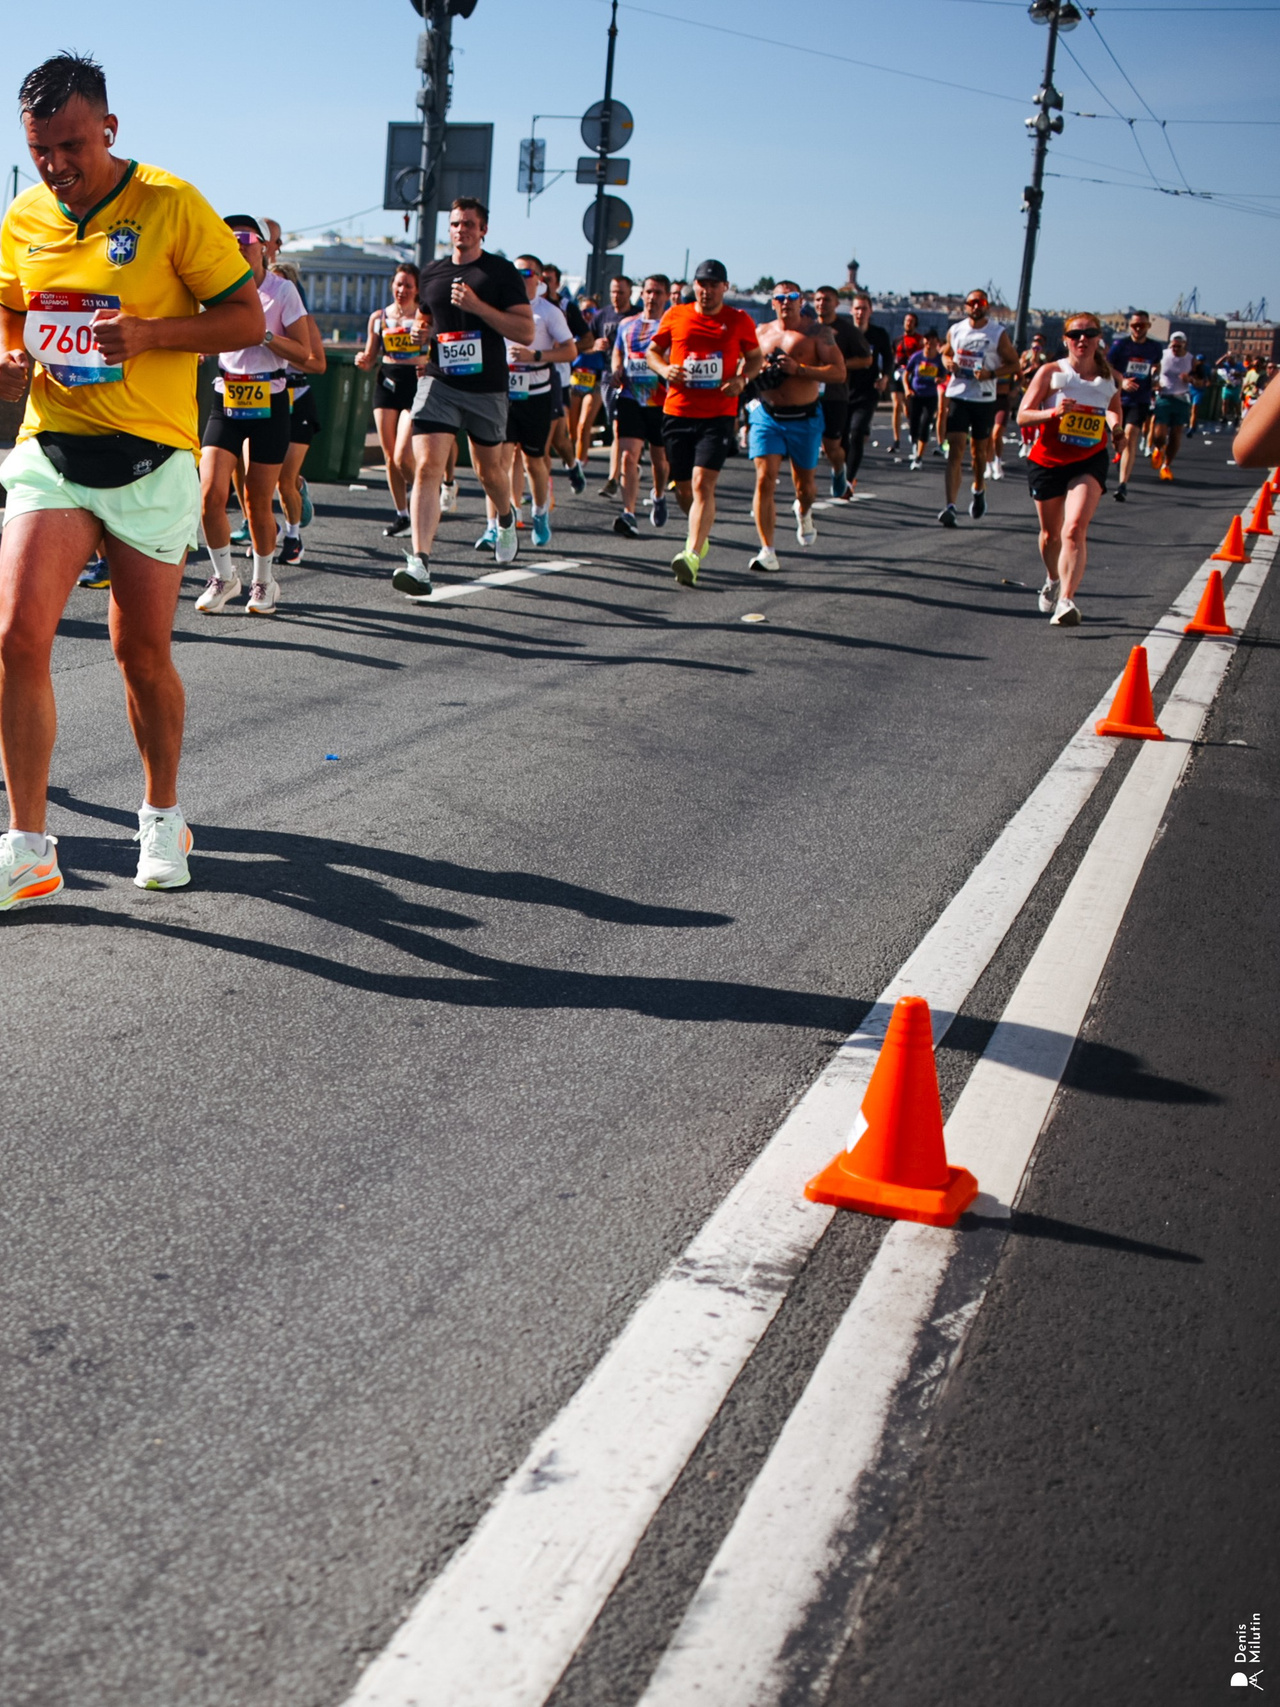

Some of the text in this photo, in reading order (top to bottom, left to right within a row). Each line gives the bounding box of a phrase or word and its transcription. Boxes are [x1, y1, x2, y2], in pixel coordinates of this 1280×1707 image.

[39, 324, 99, 354] 760
[442, 343, 476, 359] 5540
[688, 362, 718, 375] 3410
[508, 374, 524, 387] 61
[227, 384, 264, 400] 5976
[1066, 415, 1100, 432] 3108
